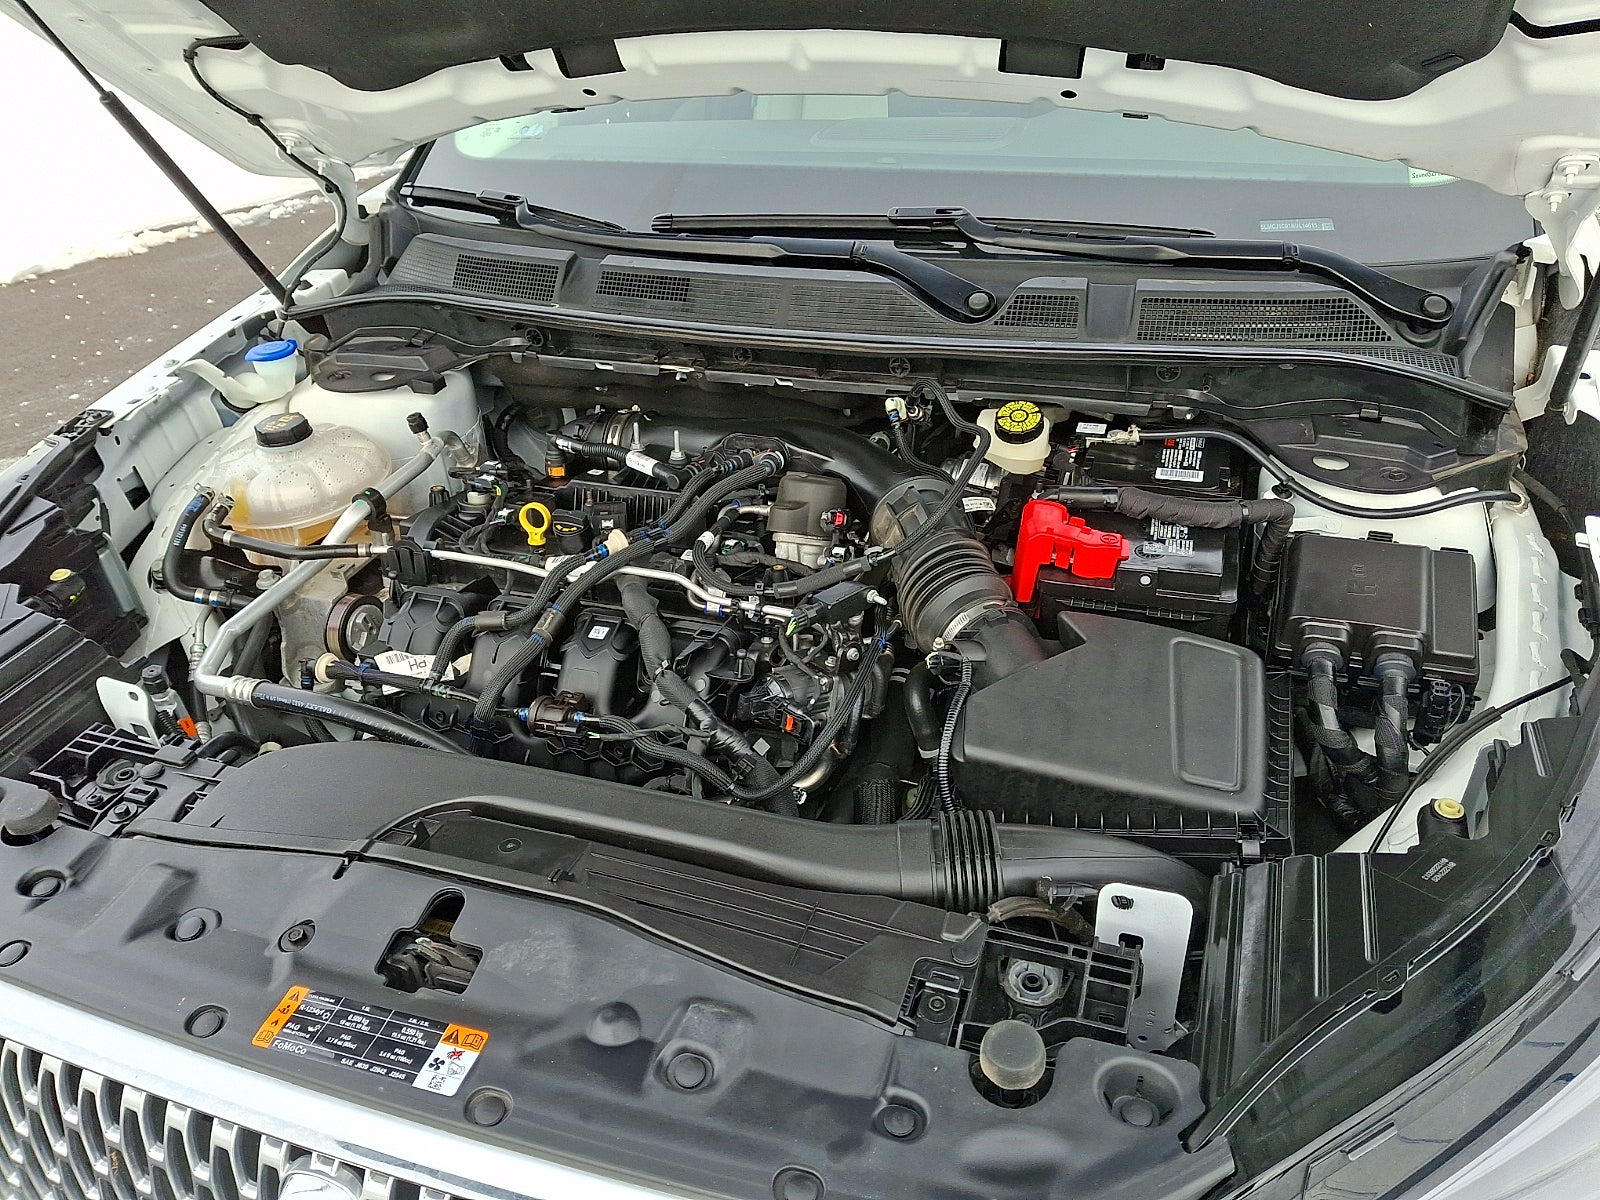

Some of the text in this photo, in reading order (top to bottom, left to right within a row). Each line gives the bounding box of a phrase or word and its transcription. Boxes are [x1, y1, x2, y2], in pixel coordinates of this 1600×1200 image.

[286, 1022, 300, 1031] PAG
[415, 1031, 424, 1039] kg
[272, 1040, 307, 1055] FoMoCo
[340, 1057, 354, 1066] SAE
